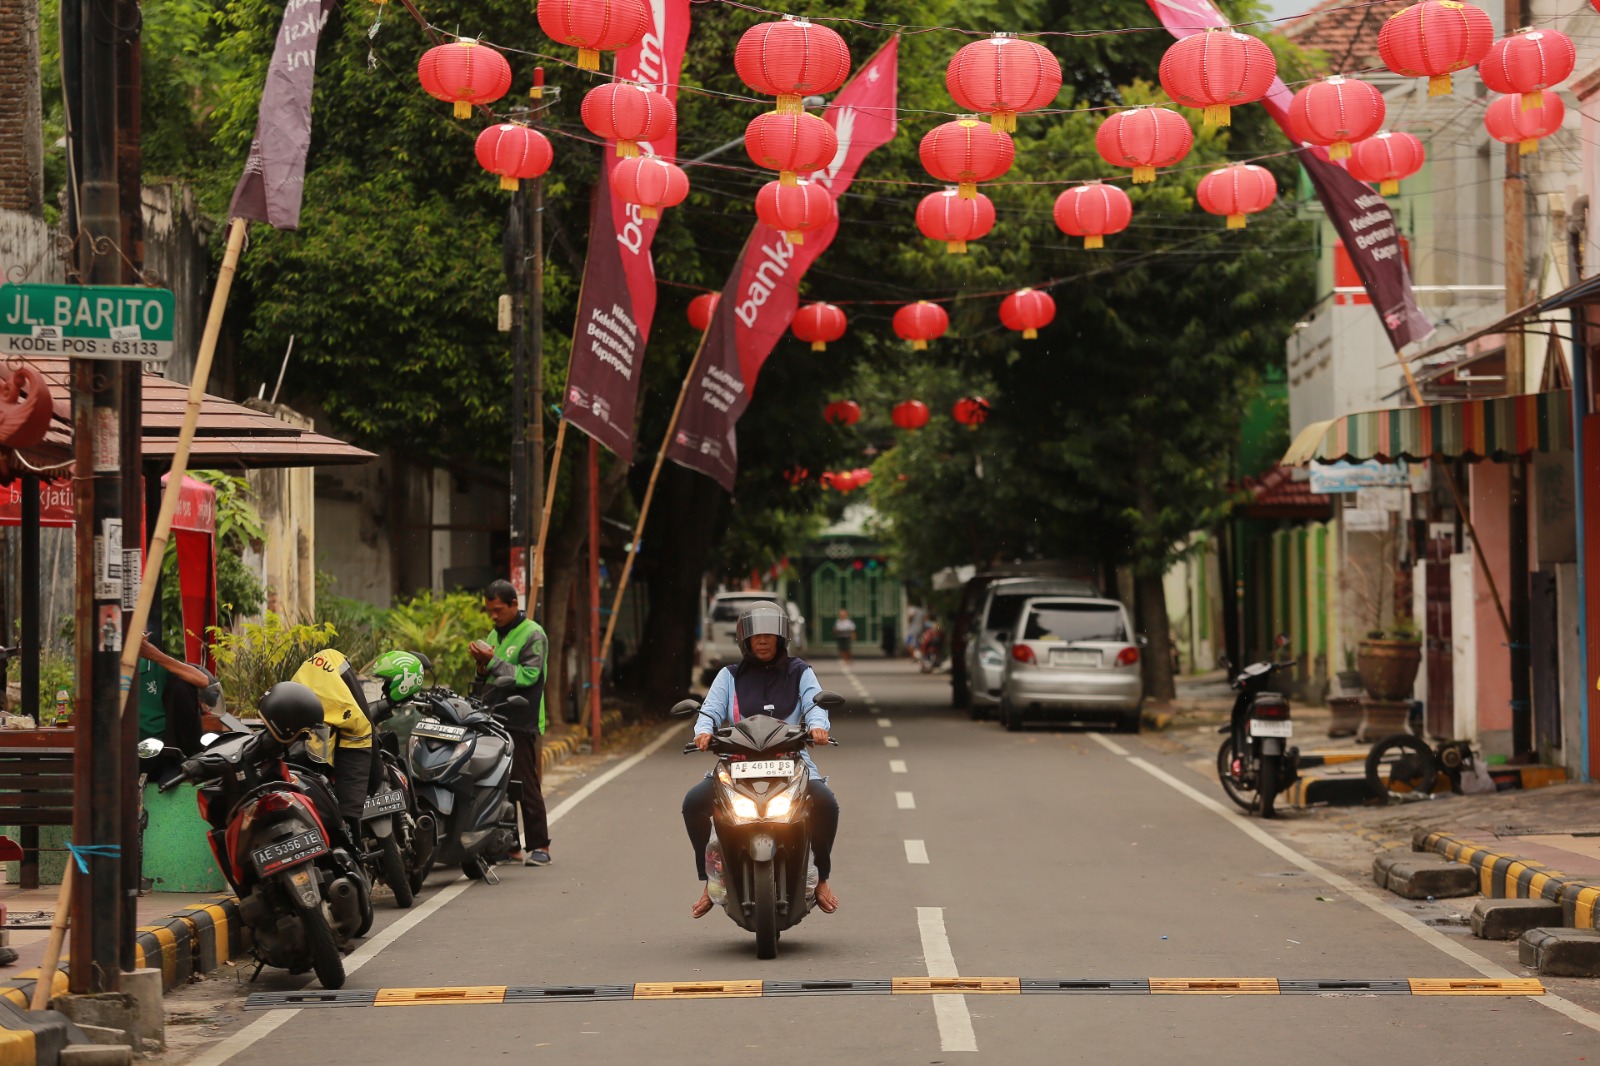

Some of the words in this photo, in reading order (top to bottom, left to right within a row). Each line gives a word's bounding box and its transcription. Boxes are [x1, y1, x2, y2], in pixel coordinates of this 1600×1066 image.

[6, 294, 45, 325] JL.
[54, 296, 164, 331] BARITO
[9, 337, 57, 351] KODE
[63, 339, 97, 352] POS
[112, 341, 158, 356] 63133
[260, 849, 273, 863] AE
[274, 839, 301, 856] 5356
[303, 833, 318, 845] IE
